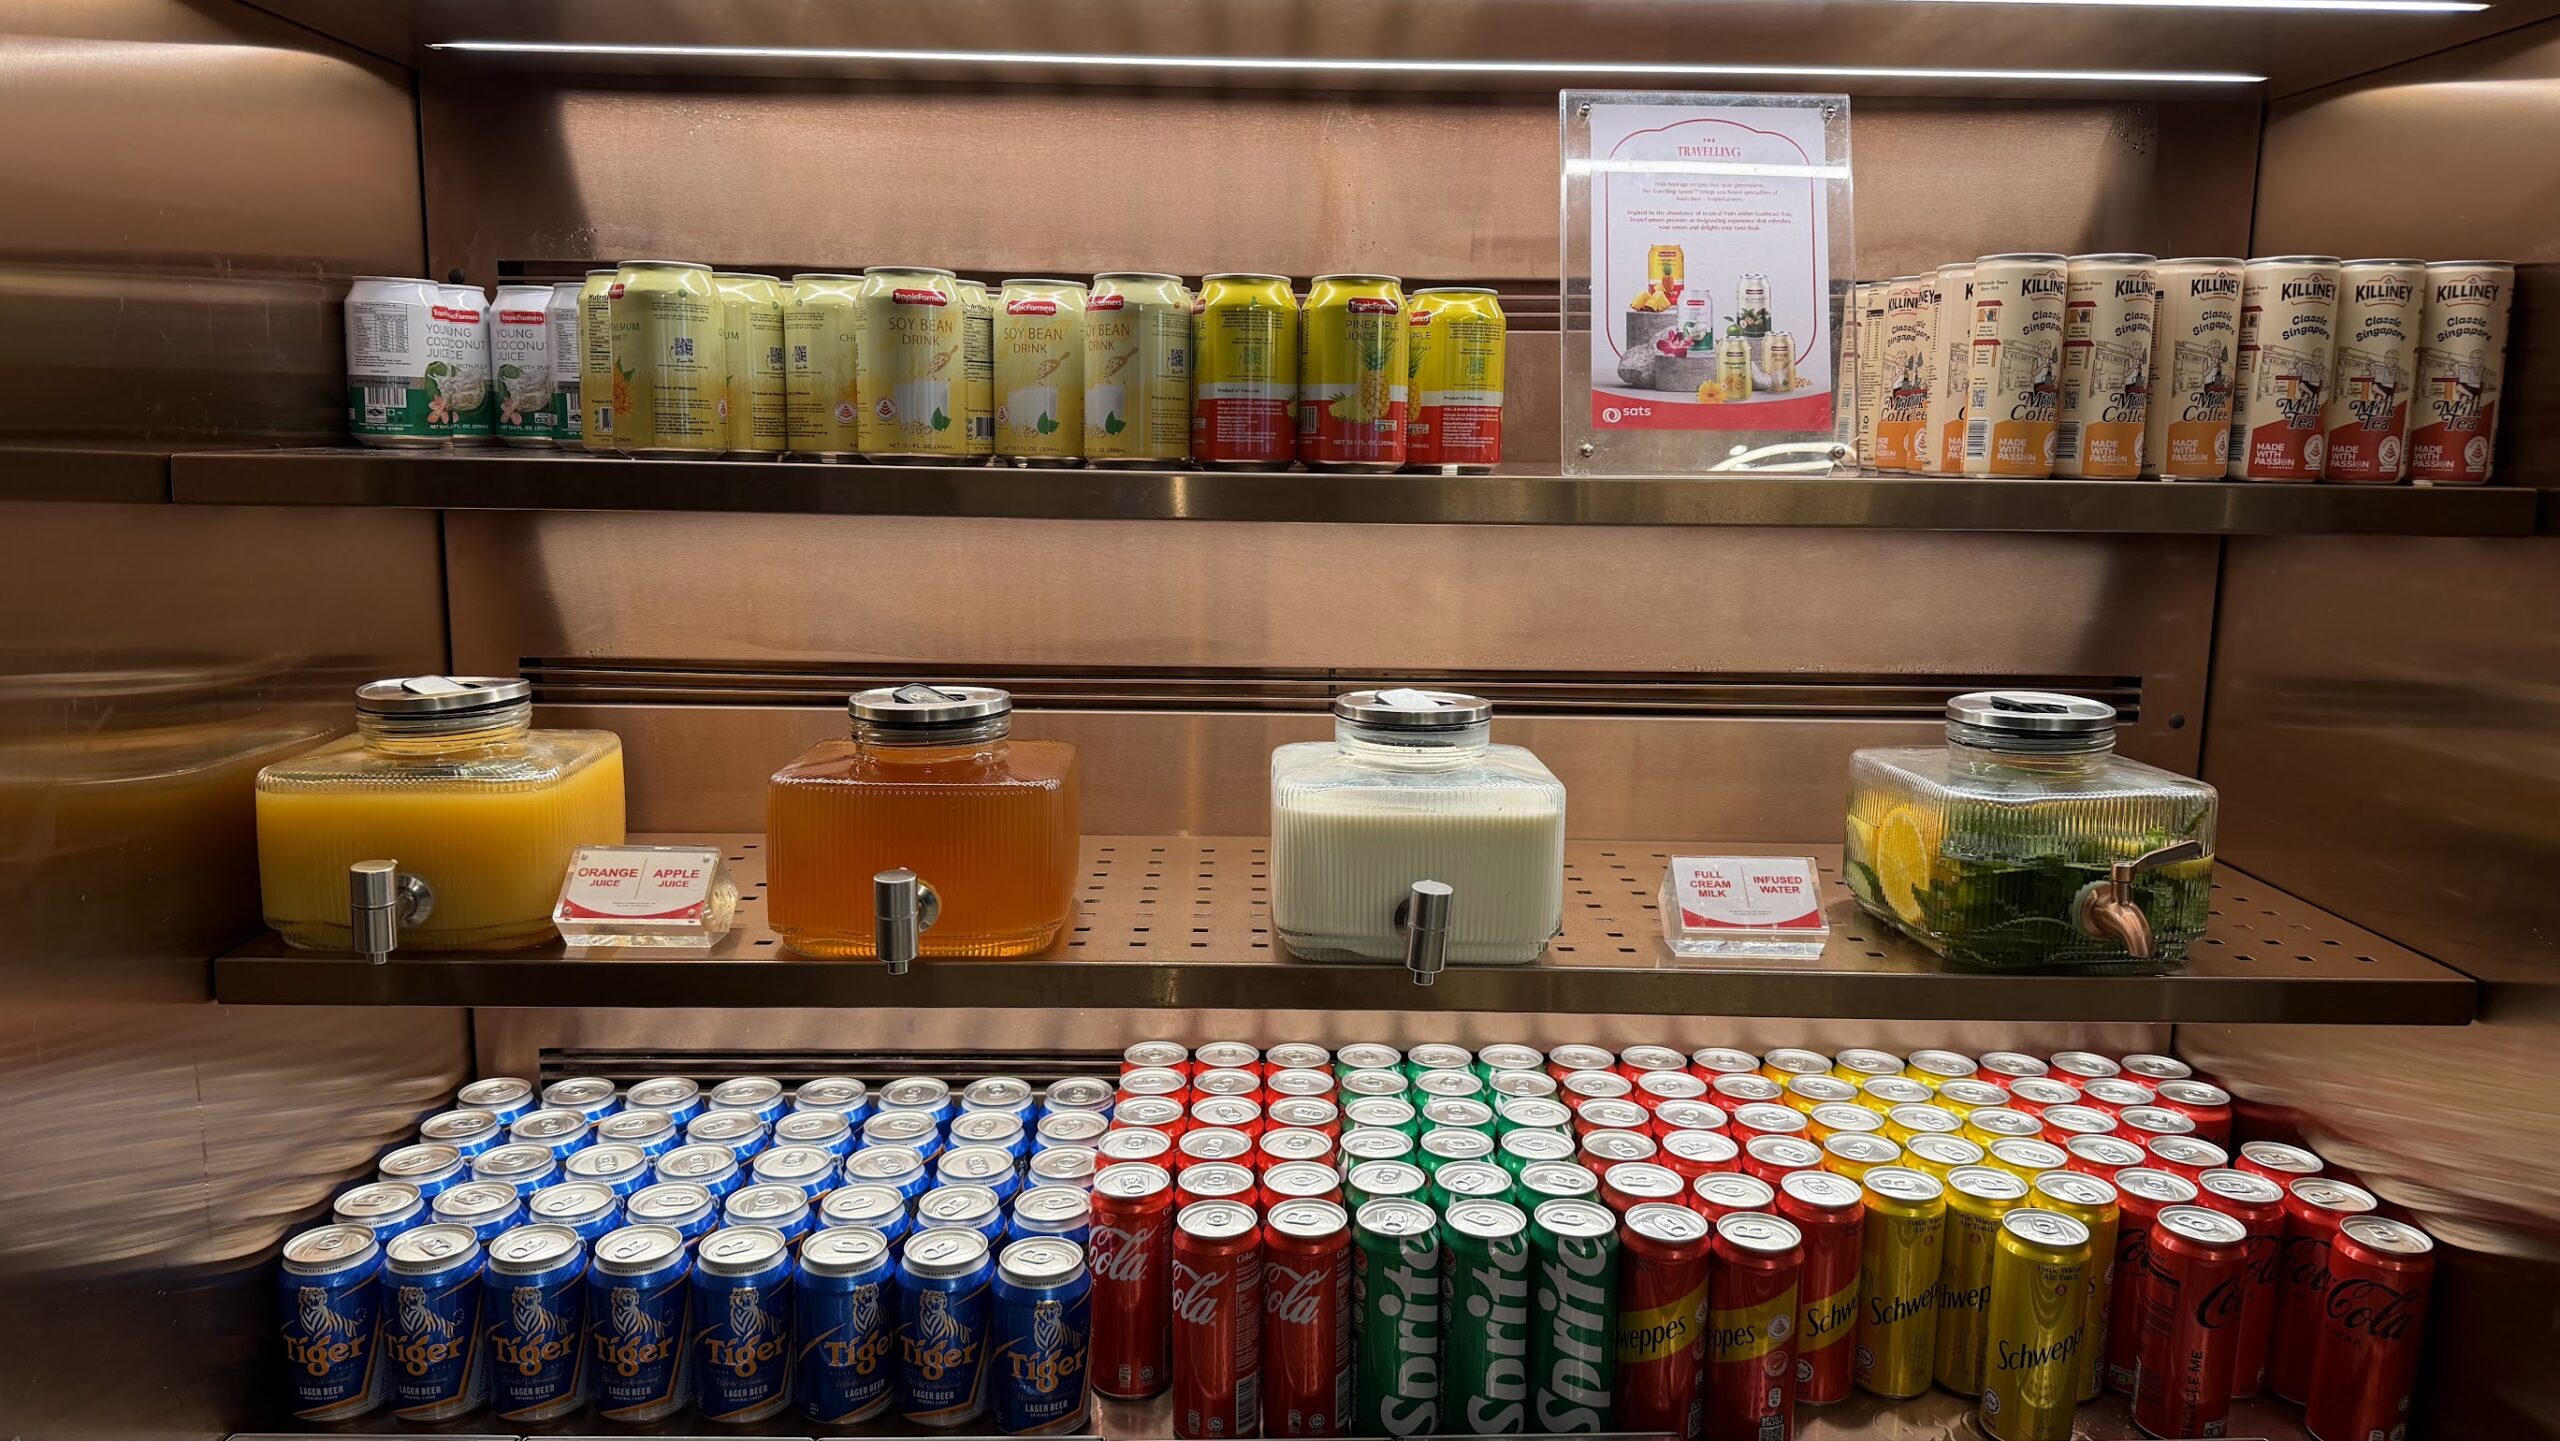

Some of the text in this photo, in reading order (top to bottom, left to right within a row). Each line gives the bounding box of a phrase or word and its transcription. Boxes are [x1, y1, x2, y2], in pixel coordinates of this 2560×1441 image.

[1677, 146, 1741, 157] TRAVELLING
[2191, 279, 2241, 298] KILLINEY
[2281, 283, 2336, 301] KILLINEY
[2355, 285, 2413, 303] KILLINEY
[2435, 285, 2500, 303] KILLINEY
[894, 291, 947, 303] TropicFarmers
[1008, 303, 1056, 313] TropicFarmers
[1350, 301, 1397, 311] TropicFarmers
[2202, 311, 2232, 322] Classic
[2292, 315, 2327, 326] Classic
[2365, 316, 2402, 328] Classic
[2447, 316, 2487, 328] Classic
[889, 317, 953, 333] SOY BEAN
[1098, 323, 1130, 337] BEAN
[1346, 320, 1399, 330] PINEAPPLE
[2192, 321, 2235, 336] Singapore
[496, 328, 534, 339] YOUNG
[1004, 327, 1063, 341] SOY BEAN
[1345, 333, 1377, 341] JUICE
[2282, 325, 2330, 341] Singapore
[2355, 326, 2406, 342] Singapore
[2436, 326, 2492, 342] Singapore
[496, 340, 545, 351] COCONU
[902, 334, 940, 346] DRINK
[1089, 340, 1115, 352] DRINK
[1013, 343, 1048, 354] DRINK
[497, 352, 525, 361] JUICE
[2190, 391, 2227, 408] Milk
[1623, 406, 1652, 416] sats
[2276, 397, 2321, 415] Milk
[2349, 399, 2395, 417] Milk
[2432, 399, 2483, 417] Milk
[2182, 405, 2228, 422] Coffee
[2284, 412, 2315, 430] Tea
[2358, 412, 2389, 431] Tea
[2441, 413, 2476, 431] Tea
[1998, 438, 2027, 447] MADE
[2091, 440, 2119, 448] MADE
[2172, 439, 2199, 447] MADE
[2256, 443, 2285, 451] MADE
[1999, 446, 2024, 454] WITH
[2091, 447, 2116, 455] WITH
[2172, 446, 2197, 454] WITH
[2256, 450, 2282, 458] WITH
[2331, 445, 2359, 453] MADE
[2413, 445, 2443, 453] MADE
[2331, 452, 2356, 461] WITH
[2413, 452, 2440, 461] WITH
[578, 868, 639, 878] ORANGE
[653, 869, 700, 879] APPLE
[1694, 870, 1723, 879] FULL
[589, 879, 621, 887] JUICE
[658, 880, 689, 888] JUICE
[1690, 880, 1731, 889] CREAM
[1753, 876, 1803, 885] INFUSED
[1698, 889, 1727, 898] MILK
[1759, 886, 1801, 894] WATER
[1974, 1215, 2000, 1227] Water
[1973, 1222, 1995, 1233] Tonik
[1870, 1280, 1938, 1326] Schwep
[1806, 1296, 1858, 1337] Schw
[1378, 1231, 1439, 1436] Sprite
[1466, 1232, 1528, 1435] Sprite
[1537, 1236, 1611, 1434] Sprite
[1617, 1316, 1686, 1356] weppes
[824, 1328, 897, 1375] Tiger
[1996, 1323, 2083, 1370] Schwepp
[282, 1334, 367, 1377] Tiger
[385, 1334, 464, 1377] Tiger
[491, 1332, 576, 1377] Tiger
[592, 1335, 674, 1377] Tiger
[705, 1331, 787, 1379] Tiger
[900, 1333, 978, 1381] Tiger
[2190, 1350, 2203, 1371] ME
[1007, 1346, 1086, 1393] Tiger
[299, 1385, 344, 1396] LAGER BEER
[399, 1385, 441, 1396] LAGER BEER
[510, 1383, 555, 1396] LAGER BEER
[608, 1385, 652, 1396] LAGER BEER
[724, 1384, 769, 1398] LAGER BEER
[844, 1379, 885, 1399] LAGER BEER
[912, 1388, 955, 1400] LAGER BEER
[1025, 1400, 1068, 1413] LAGER BEER
